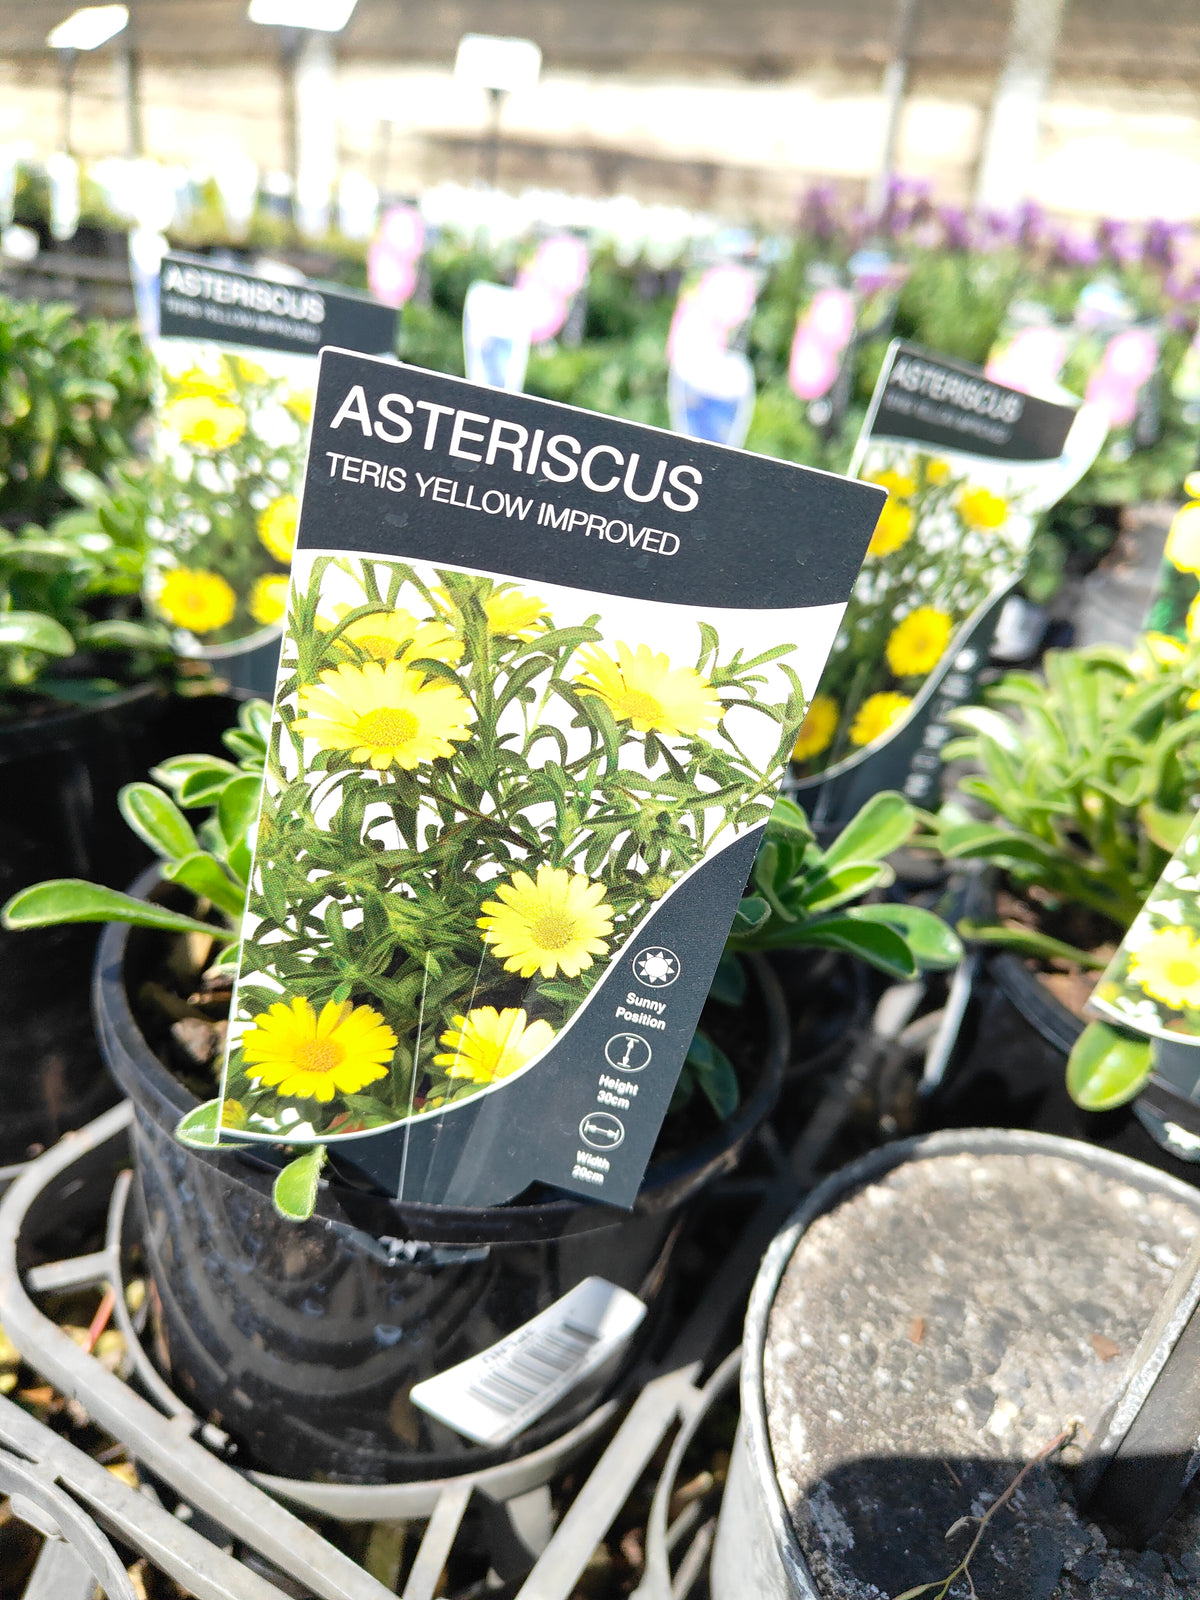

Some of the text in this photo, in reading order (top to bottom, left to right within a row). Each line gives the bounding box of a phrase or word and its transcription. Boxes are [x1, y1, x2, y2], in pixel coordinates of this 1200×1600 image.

[164, 265, 326, 324] ASTERISCUS
[889, 356, 1024, 424] ASTERISCUS
[330, 384, 703, 513] ASTERISCUS
[326, 451, 681, 557] TERIS YELLOW IMPROVED
[626, 992, 667, 1014] Sunny
[615, 1006, 667, 1031] Position
[598, 1074, 639, 1097] Height
[597, 1090, 630, 1111] 30cm
[576, 1150, 610, 1173] Width
